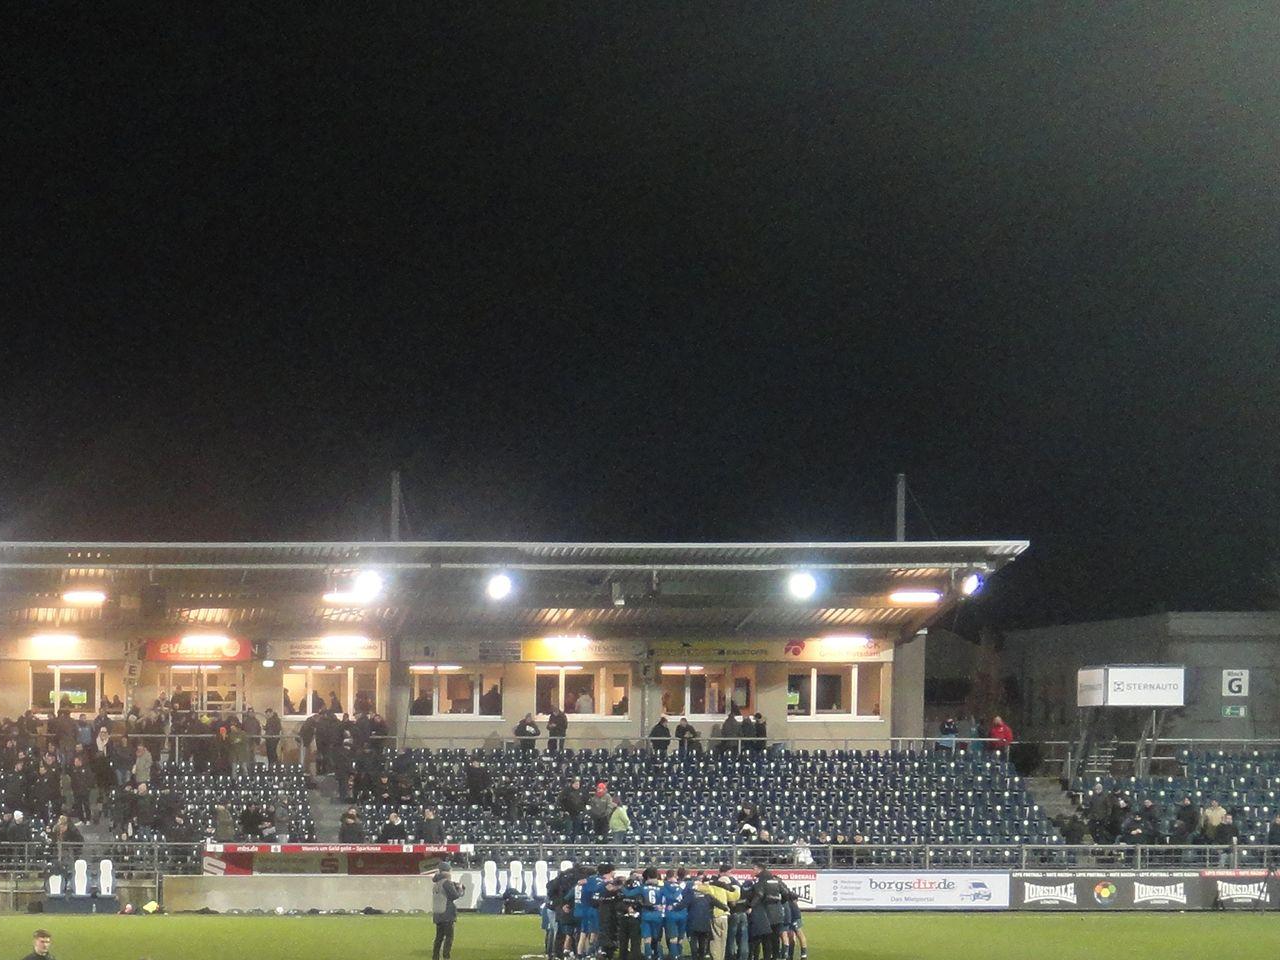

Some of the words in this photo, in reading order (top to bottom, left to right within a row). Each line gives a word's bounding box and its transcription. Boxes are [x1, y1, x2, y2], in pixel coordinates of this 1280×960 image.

[1126, 683, 1179, 691] STERNAUTO
[1228, 678, 1242, 694] G
[868, 878, 955, 891] borgsdir.de
[1133, 881, 1187, 904] LONSDALE
[1216, 880, 1270, 902] LONSDALE
[648, 889, 656, 904] 6
[1024, 882, 1077, 904] LONSDALE
